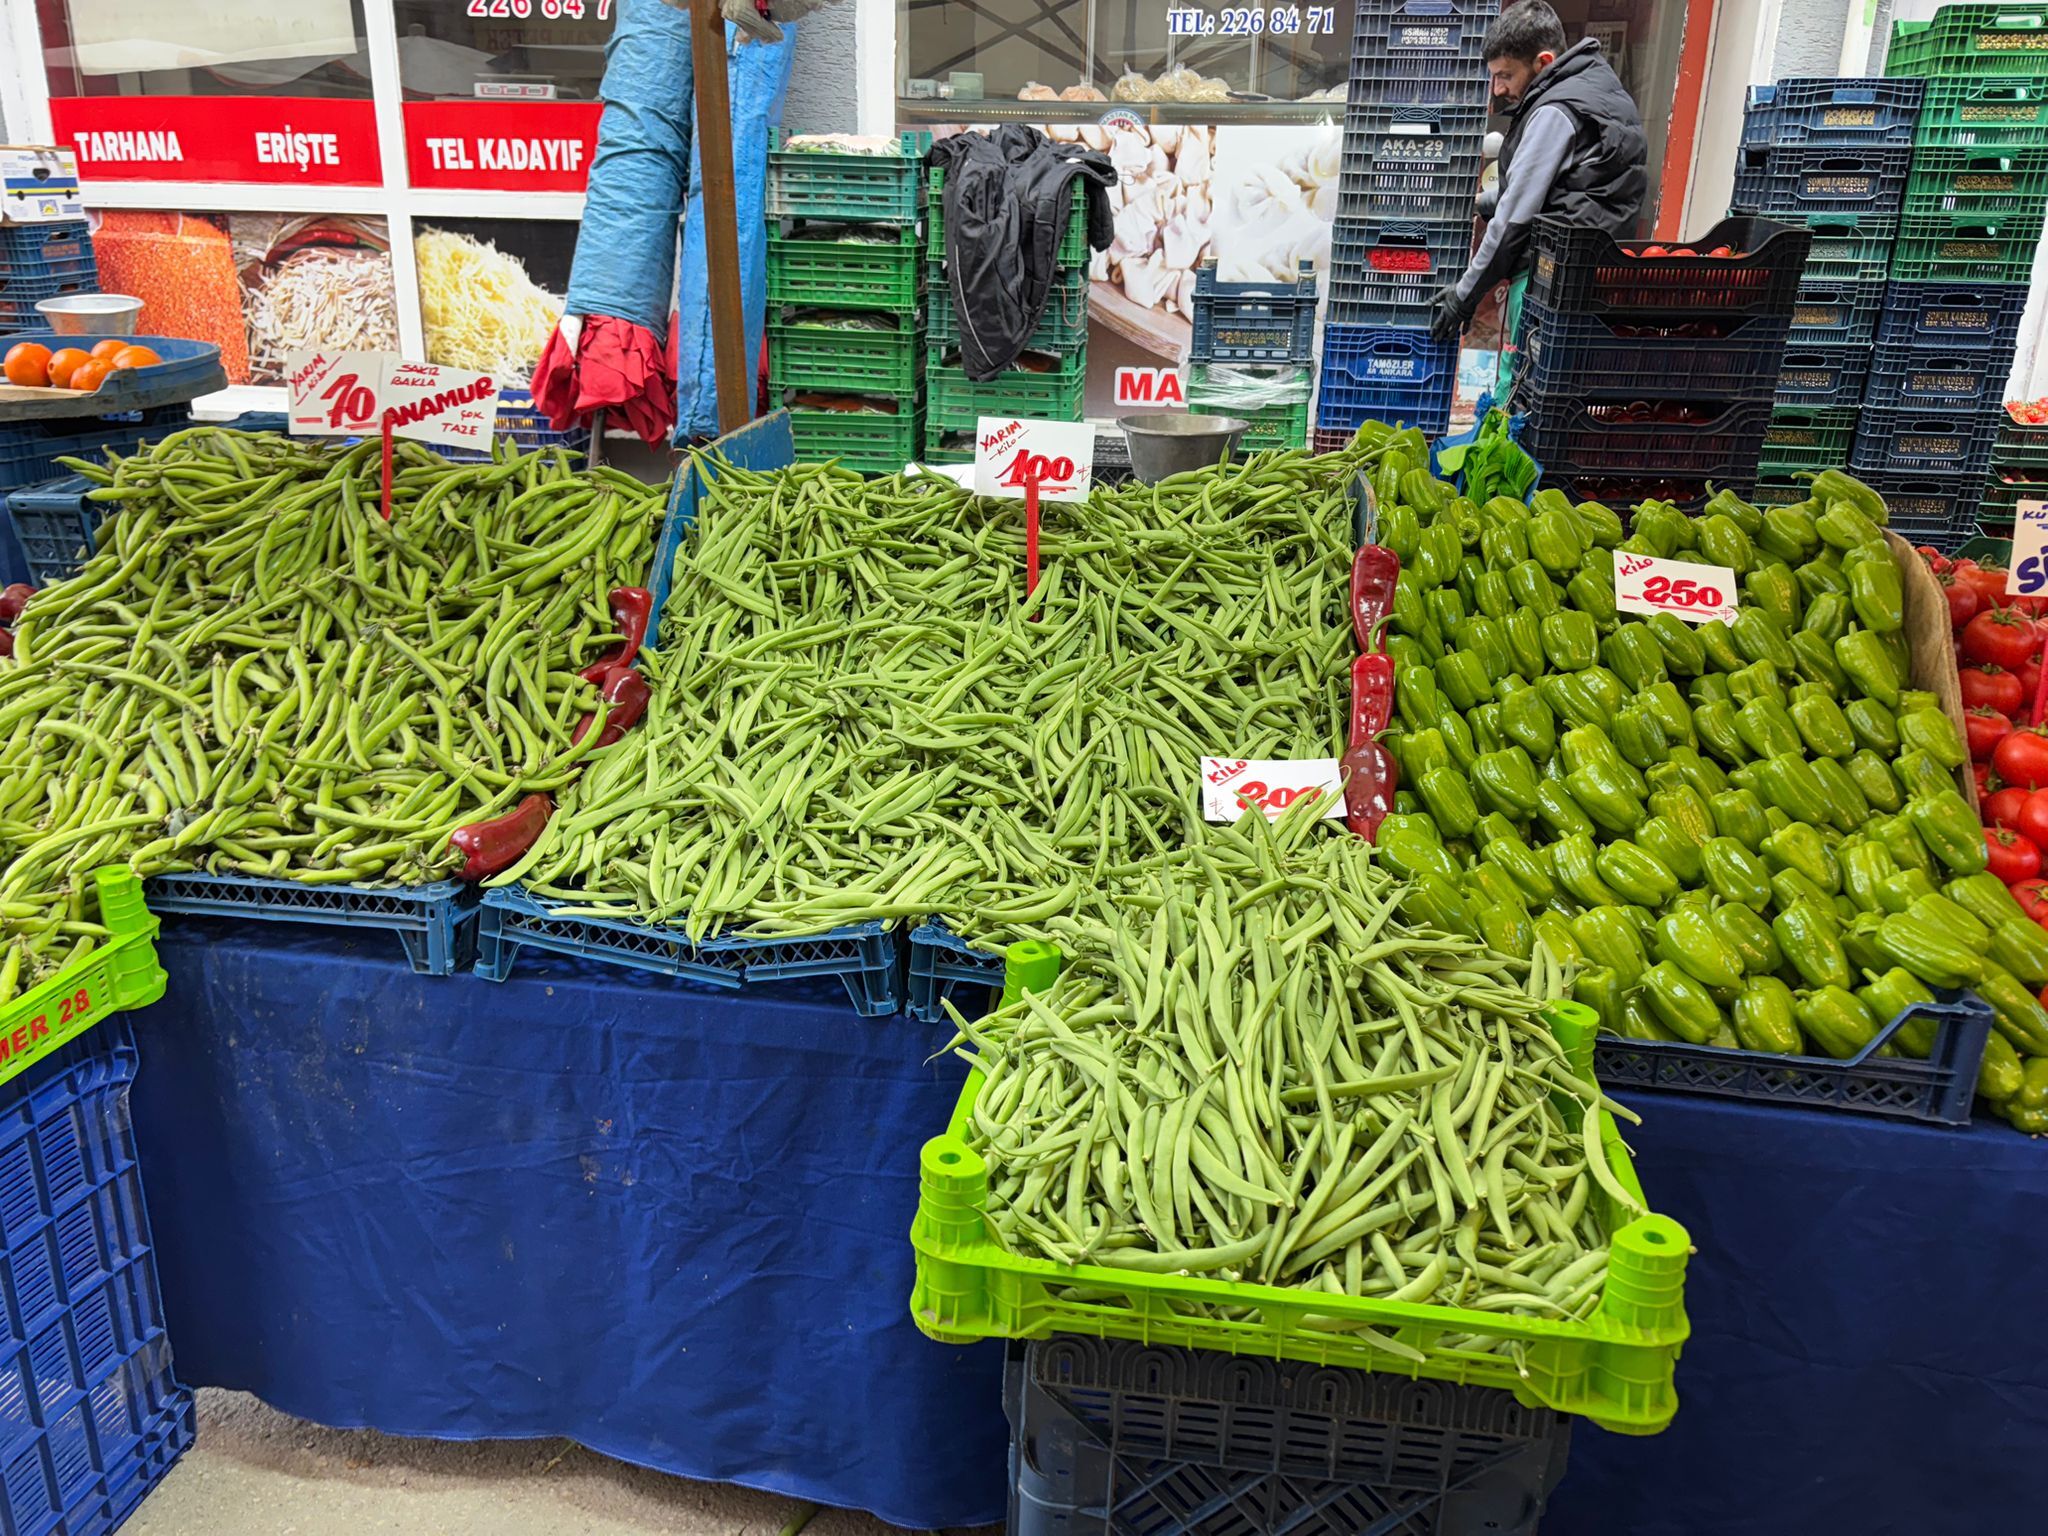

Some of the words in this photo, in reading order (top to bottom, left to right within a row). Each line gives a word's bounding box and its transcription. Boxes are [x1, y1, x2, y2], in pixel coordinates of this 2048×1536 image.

[1167, 9, 1215, 35] TEL:
[1219, 8, 1264, 34] 226
[1270, 7, 1300, 34] 84
[1307, 7, 1334, 34] 71
[73, 131, 184, 161] TARHANA
[255, 125, 340, 172] ERİŞTE
[426, 138, 474, 170] TEL
[477, 138, 583, 171] KADAYIF
[1382, 139, 1444, 151] AKA-29
[289, 353, 327, 397] YARIM
[390, 376, 436, 387] BAKLA
[1378, 368, 1413, 377] ANKARA
[382, 377, 496, 429] ANAMUR
[441, 422, 479, 436] TAZE
[980, 420, 1022, 452] YARIM
[994, 449, 1075, 482] 100
[1642, 576, 1723, 608] 250
[58, 988, 91, 1025] 28
